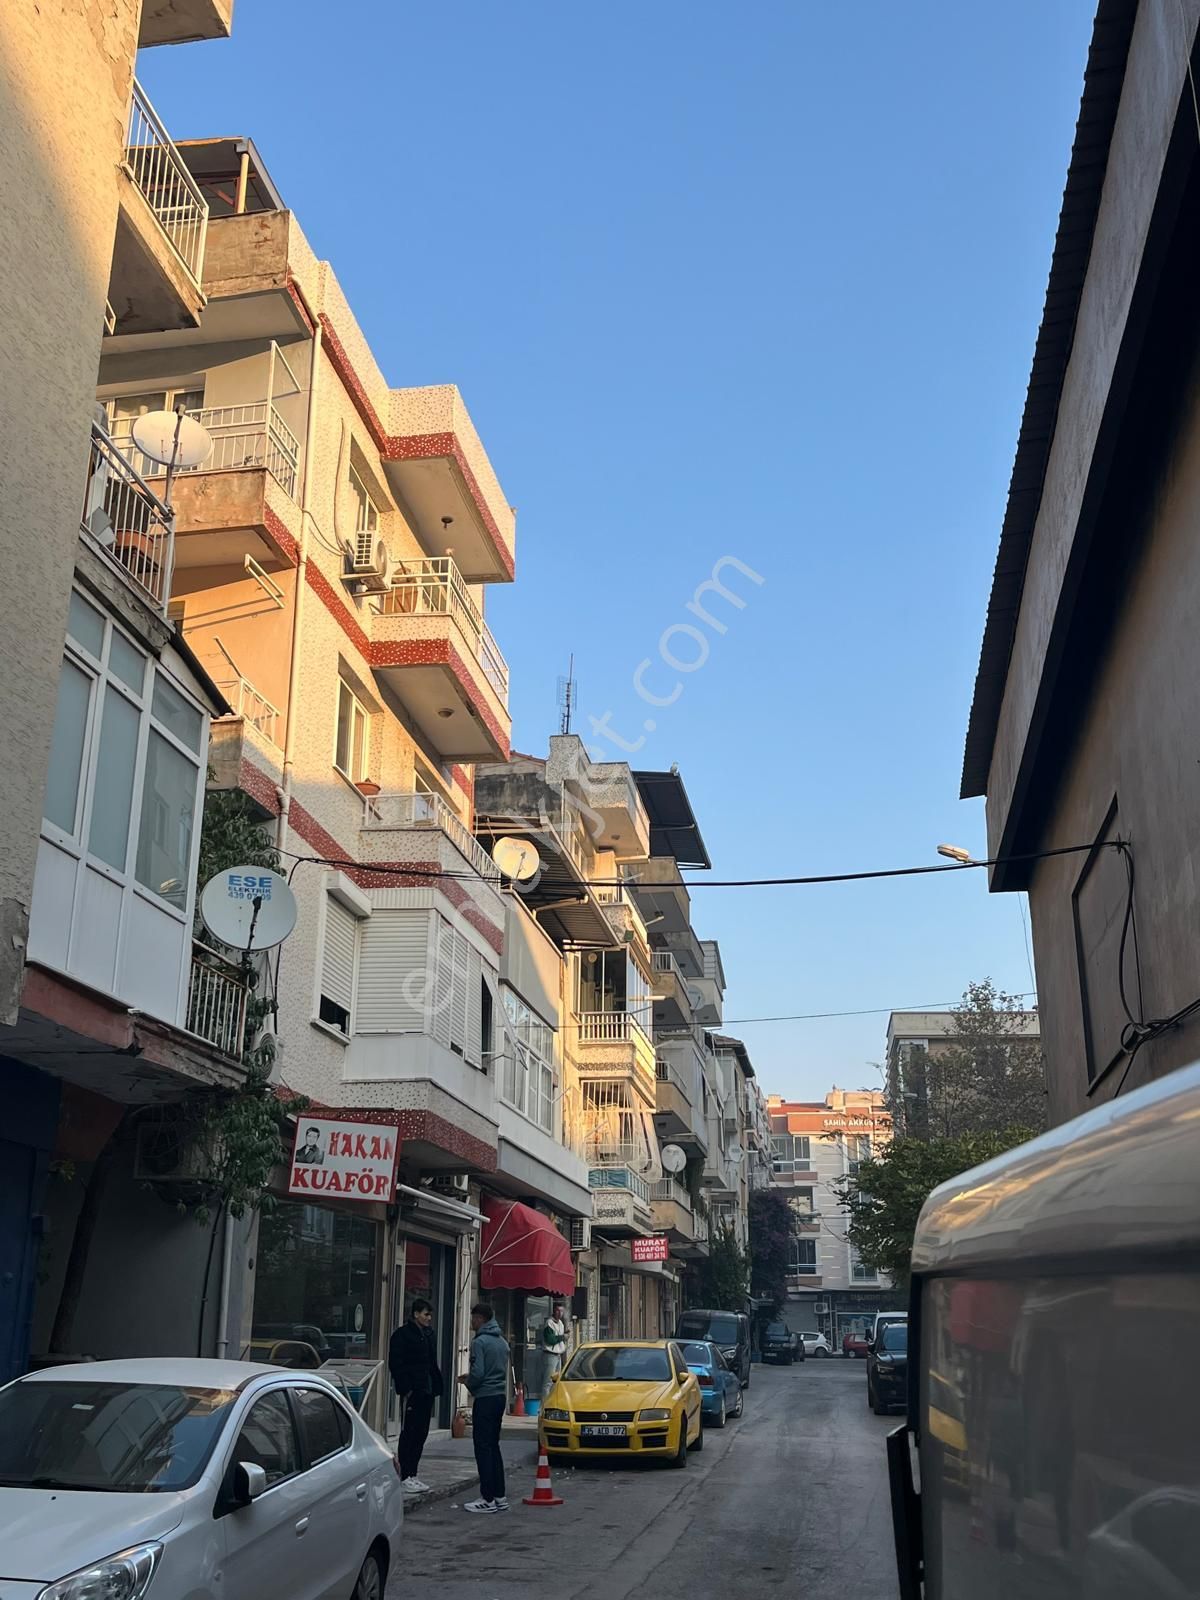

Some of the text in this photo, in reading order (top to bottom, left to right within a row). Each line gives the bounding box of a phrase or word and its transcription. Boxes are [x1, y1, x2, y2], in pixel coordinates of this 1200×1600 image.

[228, 875, 272, 887] ESE
[228, 891, 244, 900] 439
[329, 1131, 395, 1160] HAKAN
[291, 1167, 389, 1195] KUAFÖR
